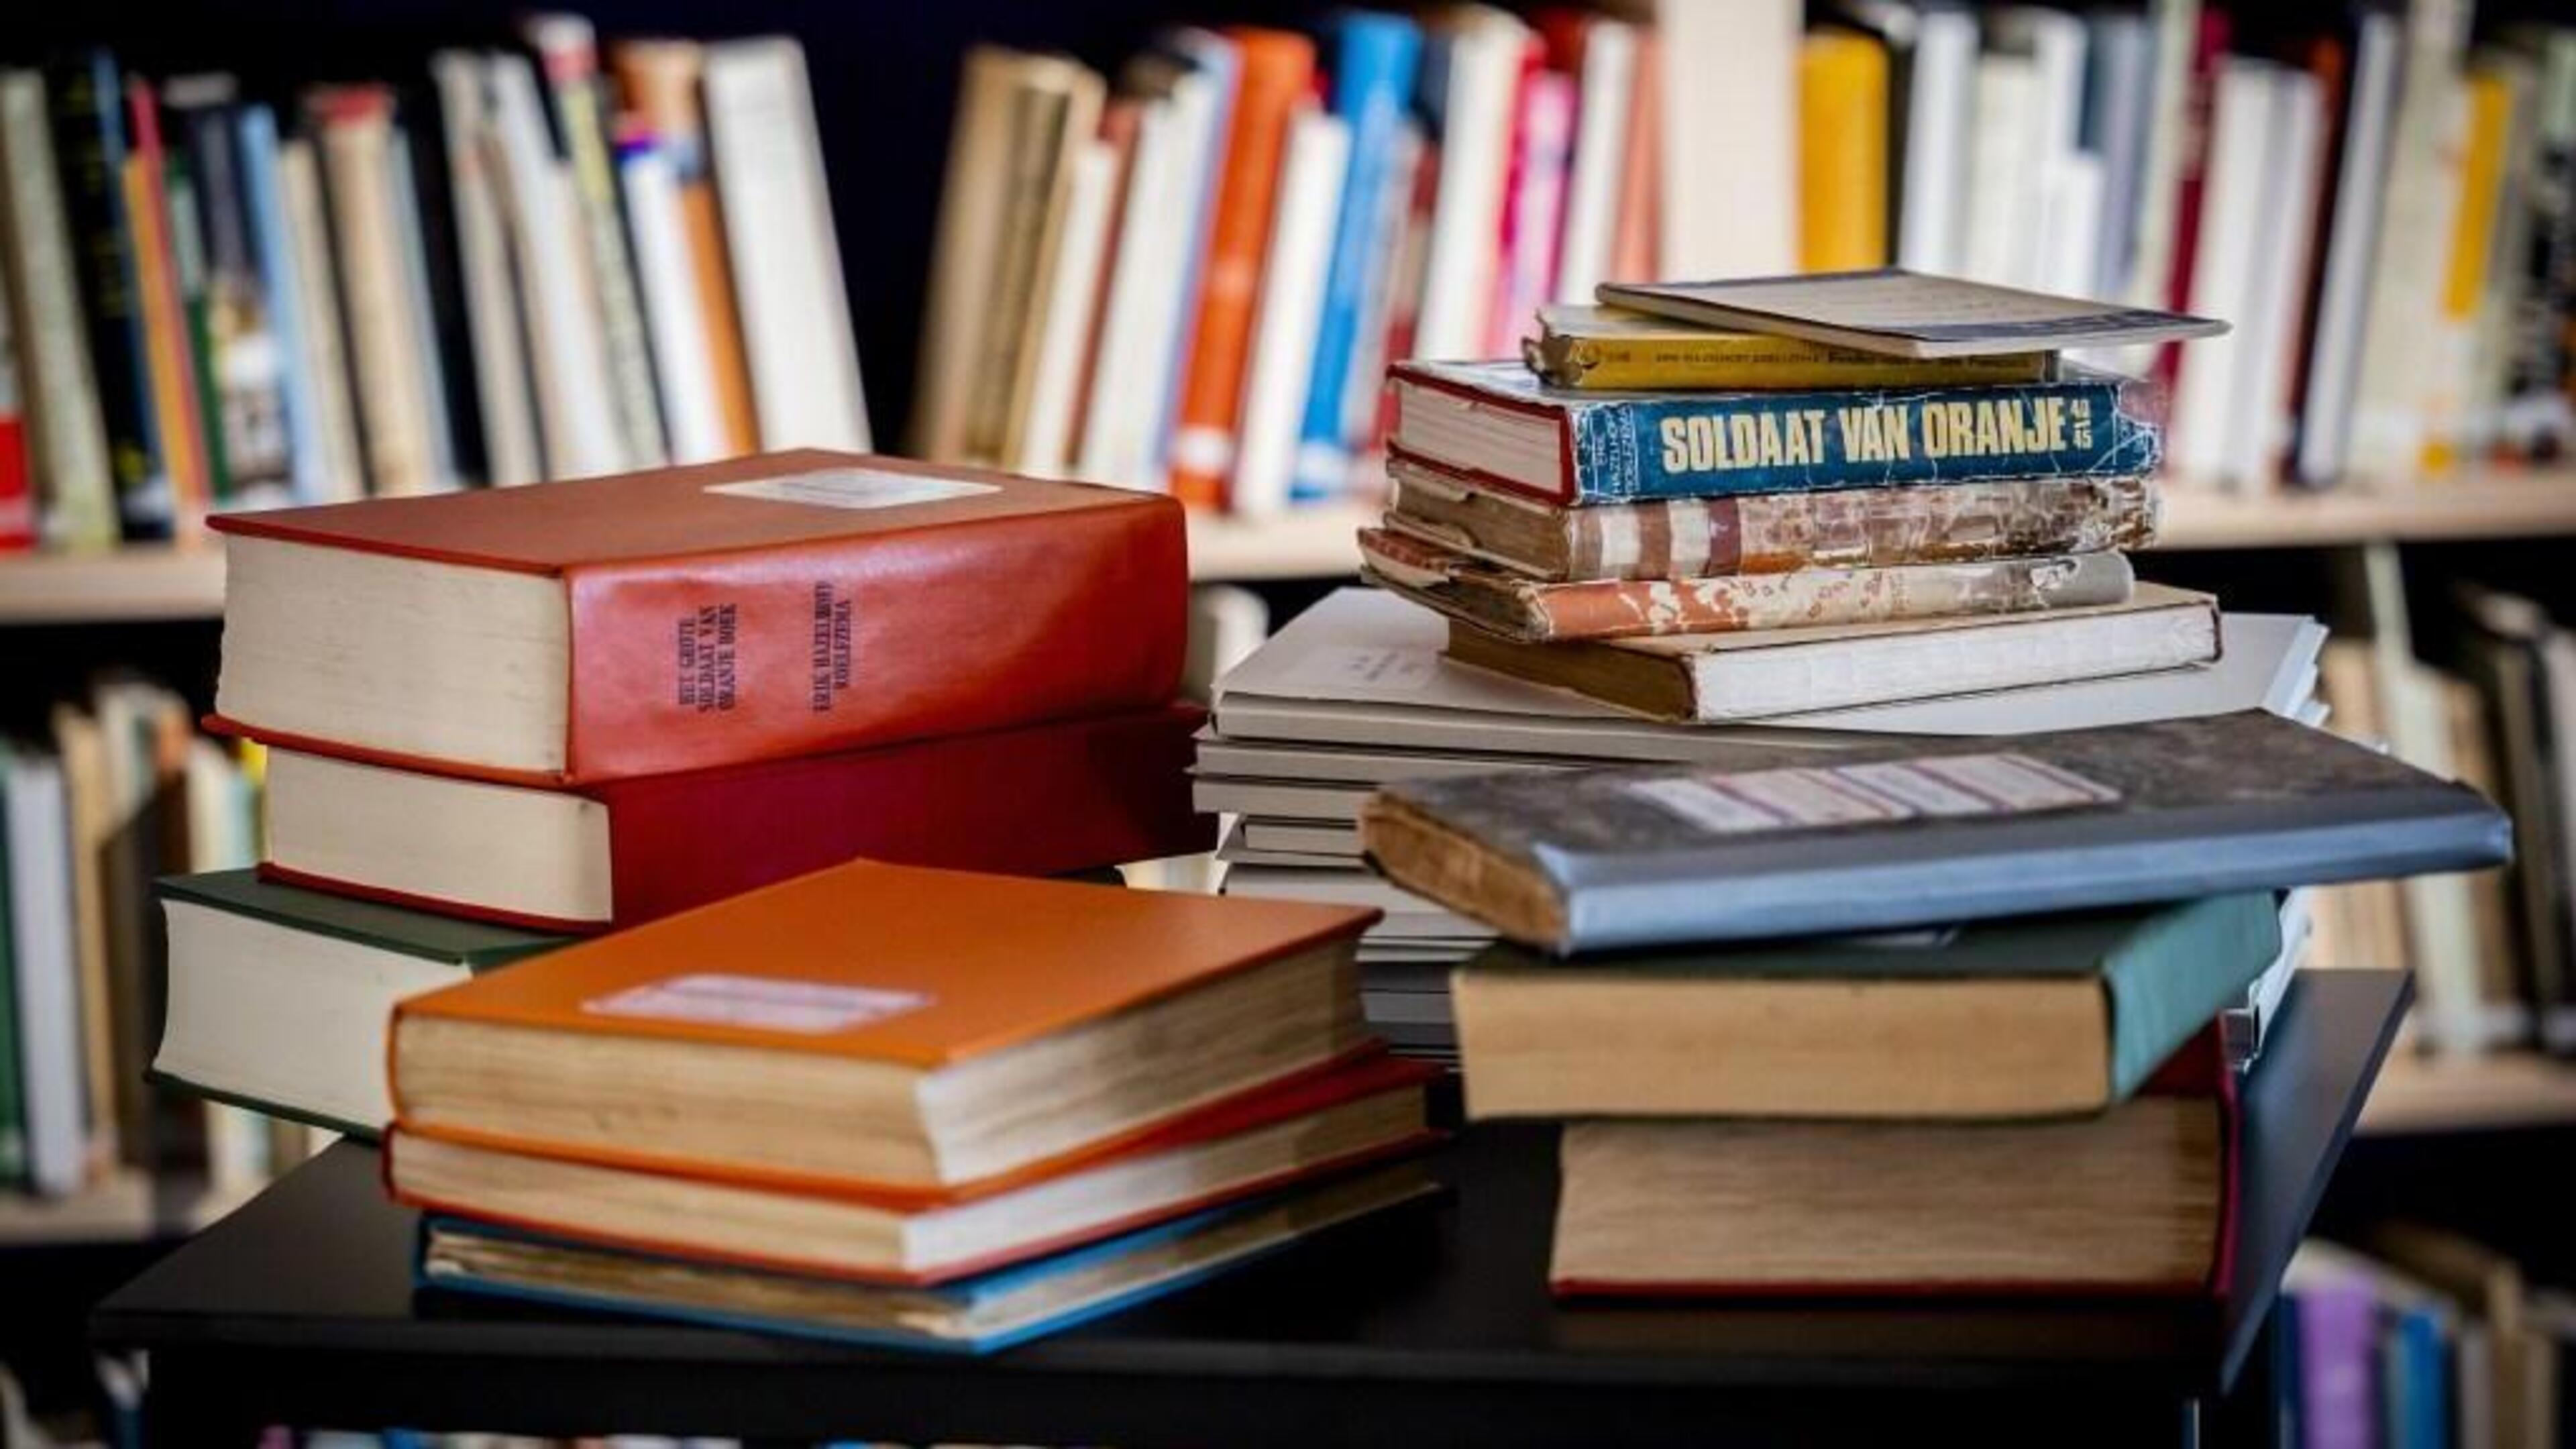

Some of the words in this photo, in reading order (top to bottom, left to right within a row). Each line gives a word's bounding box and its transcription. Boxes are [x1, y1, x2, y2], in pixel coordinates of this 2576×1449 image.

[1660, 409, 1825, 474] SOLDAAT
[1839, 405, 1911, 463] VAN
[1922, 396, 2067, 458] ORANJE
[698, 604, 717, 637] VAN
[718, 603, 737, 645] BOEK
[698, 643, 716, 712] SOLDAAT
[718, 649, 735, 710] ORANJE
